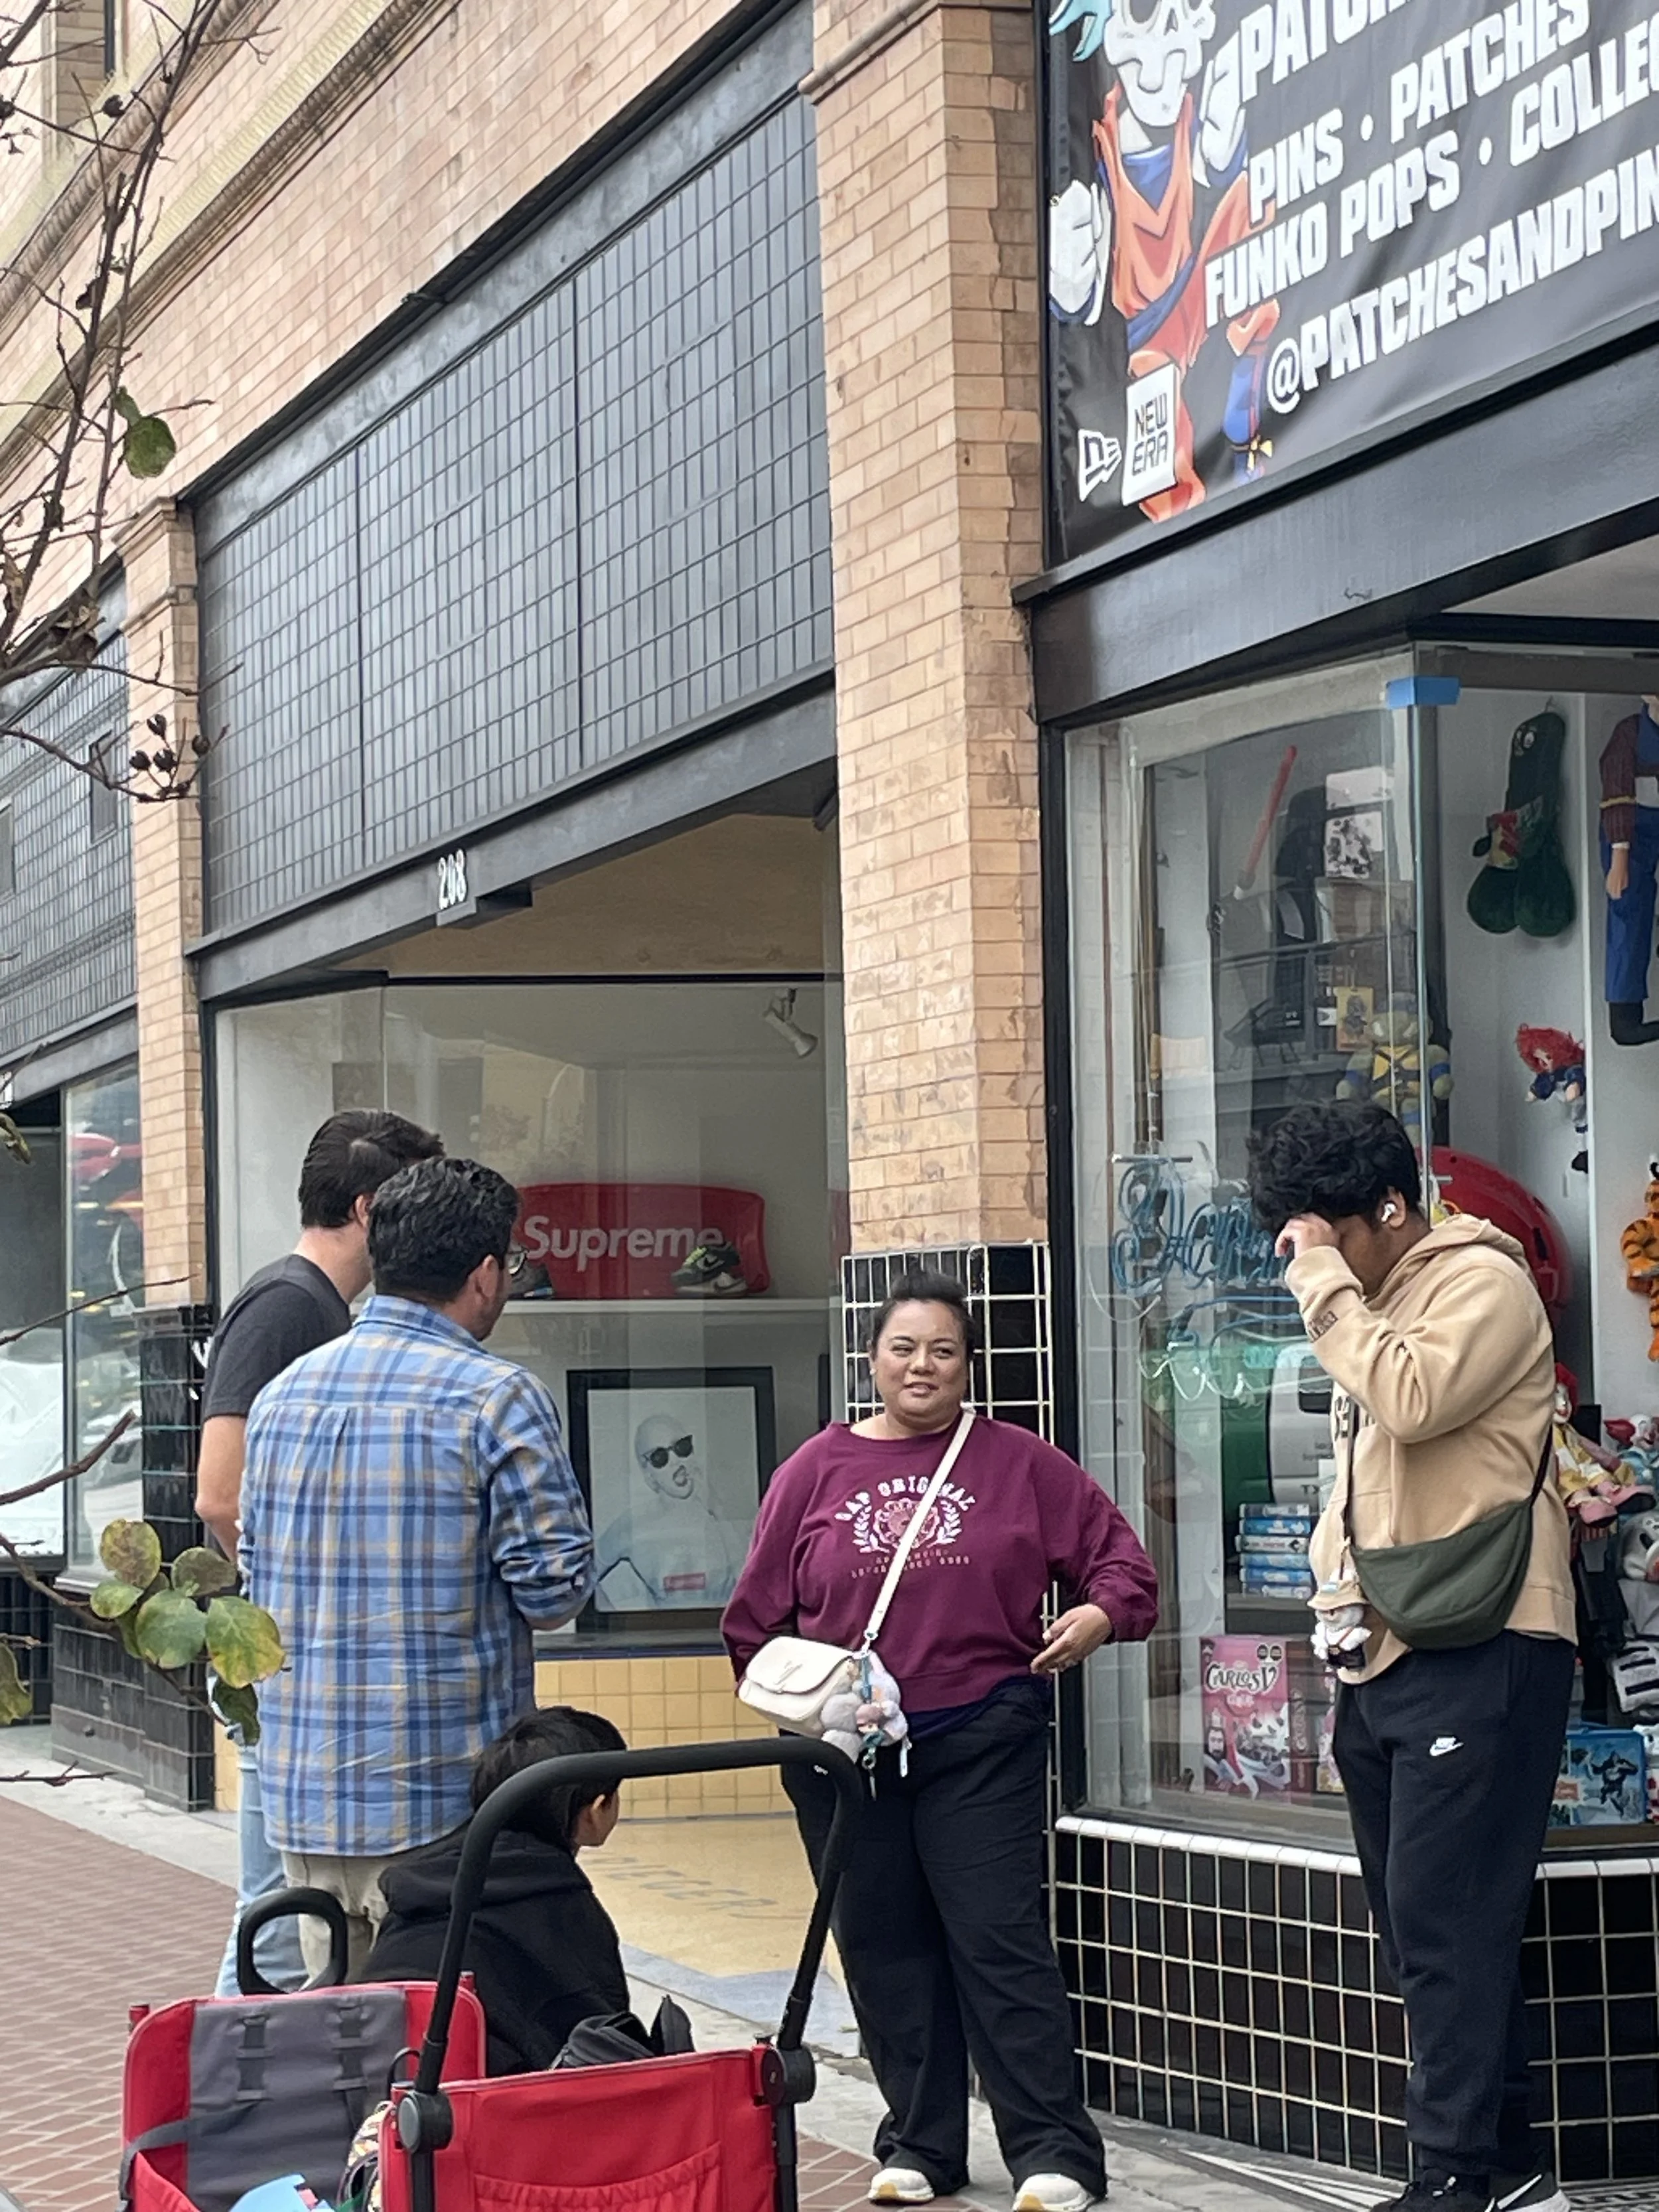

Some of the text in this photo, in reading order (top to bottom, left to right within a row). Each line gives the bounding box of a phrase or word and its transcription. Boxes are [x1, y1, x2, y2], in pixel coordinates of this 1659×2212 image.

[1250, 0, 1591, 224] PINS PATCHES
[1204, 201, 1328, 329] FUNKO
[1340, 129, 1460, 258] POPS
[1134, 392, 1167, 441] NEW
[1132, 430, 1169, 477] ERA
[438, 849, 467, 910] 208
[524, 1215, 723, 1272] Supreme
